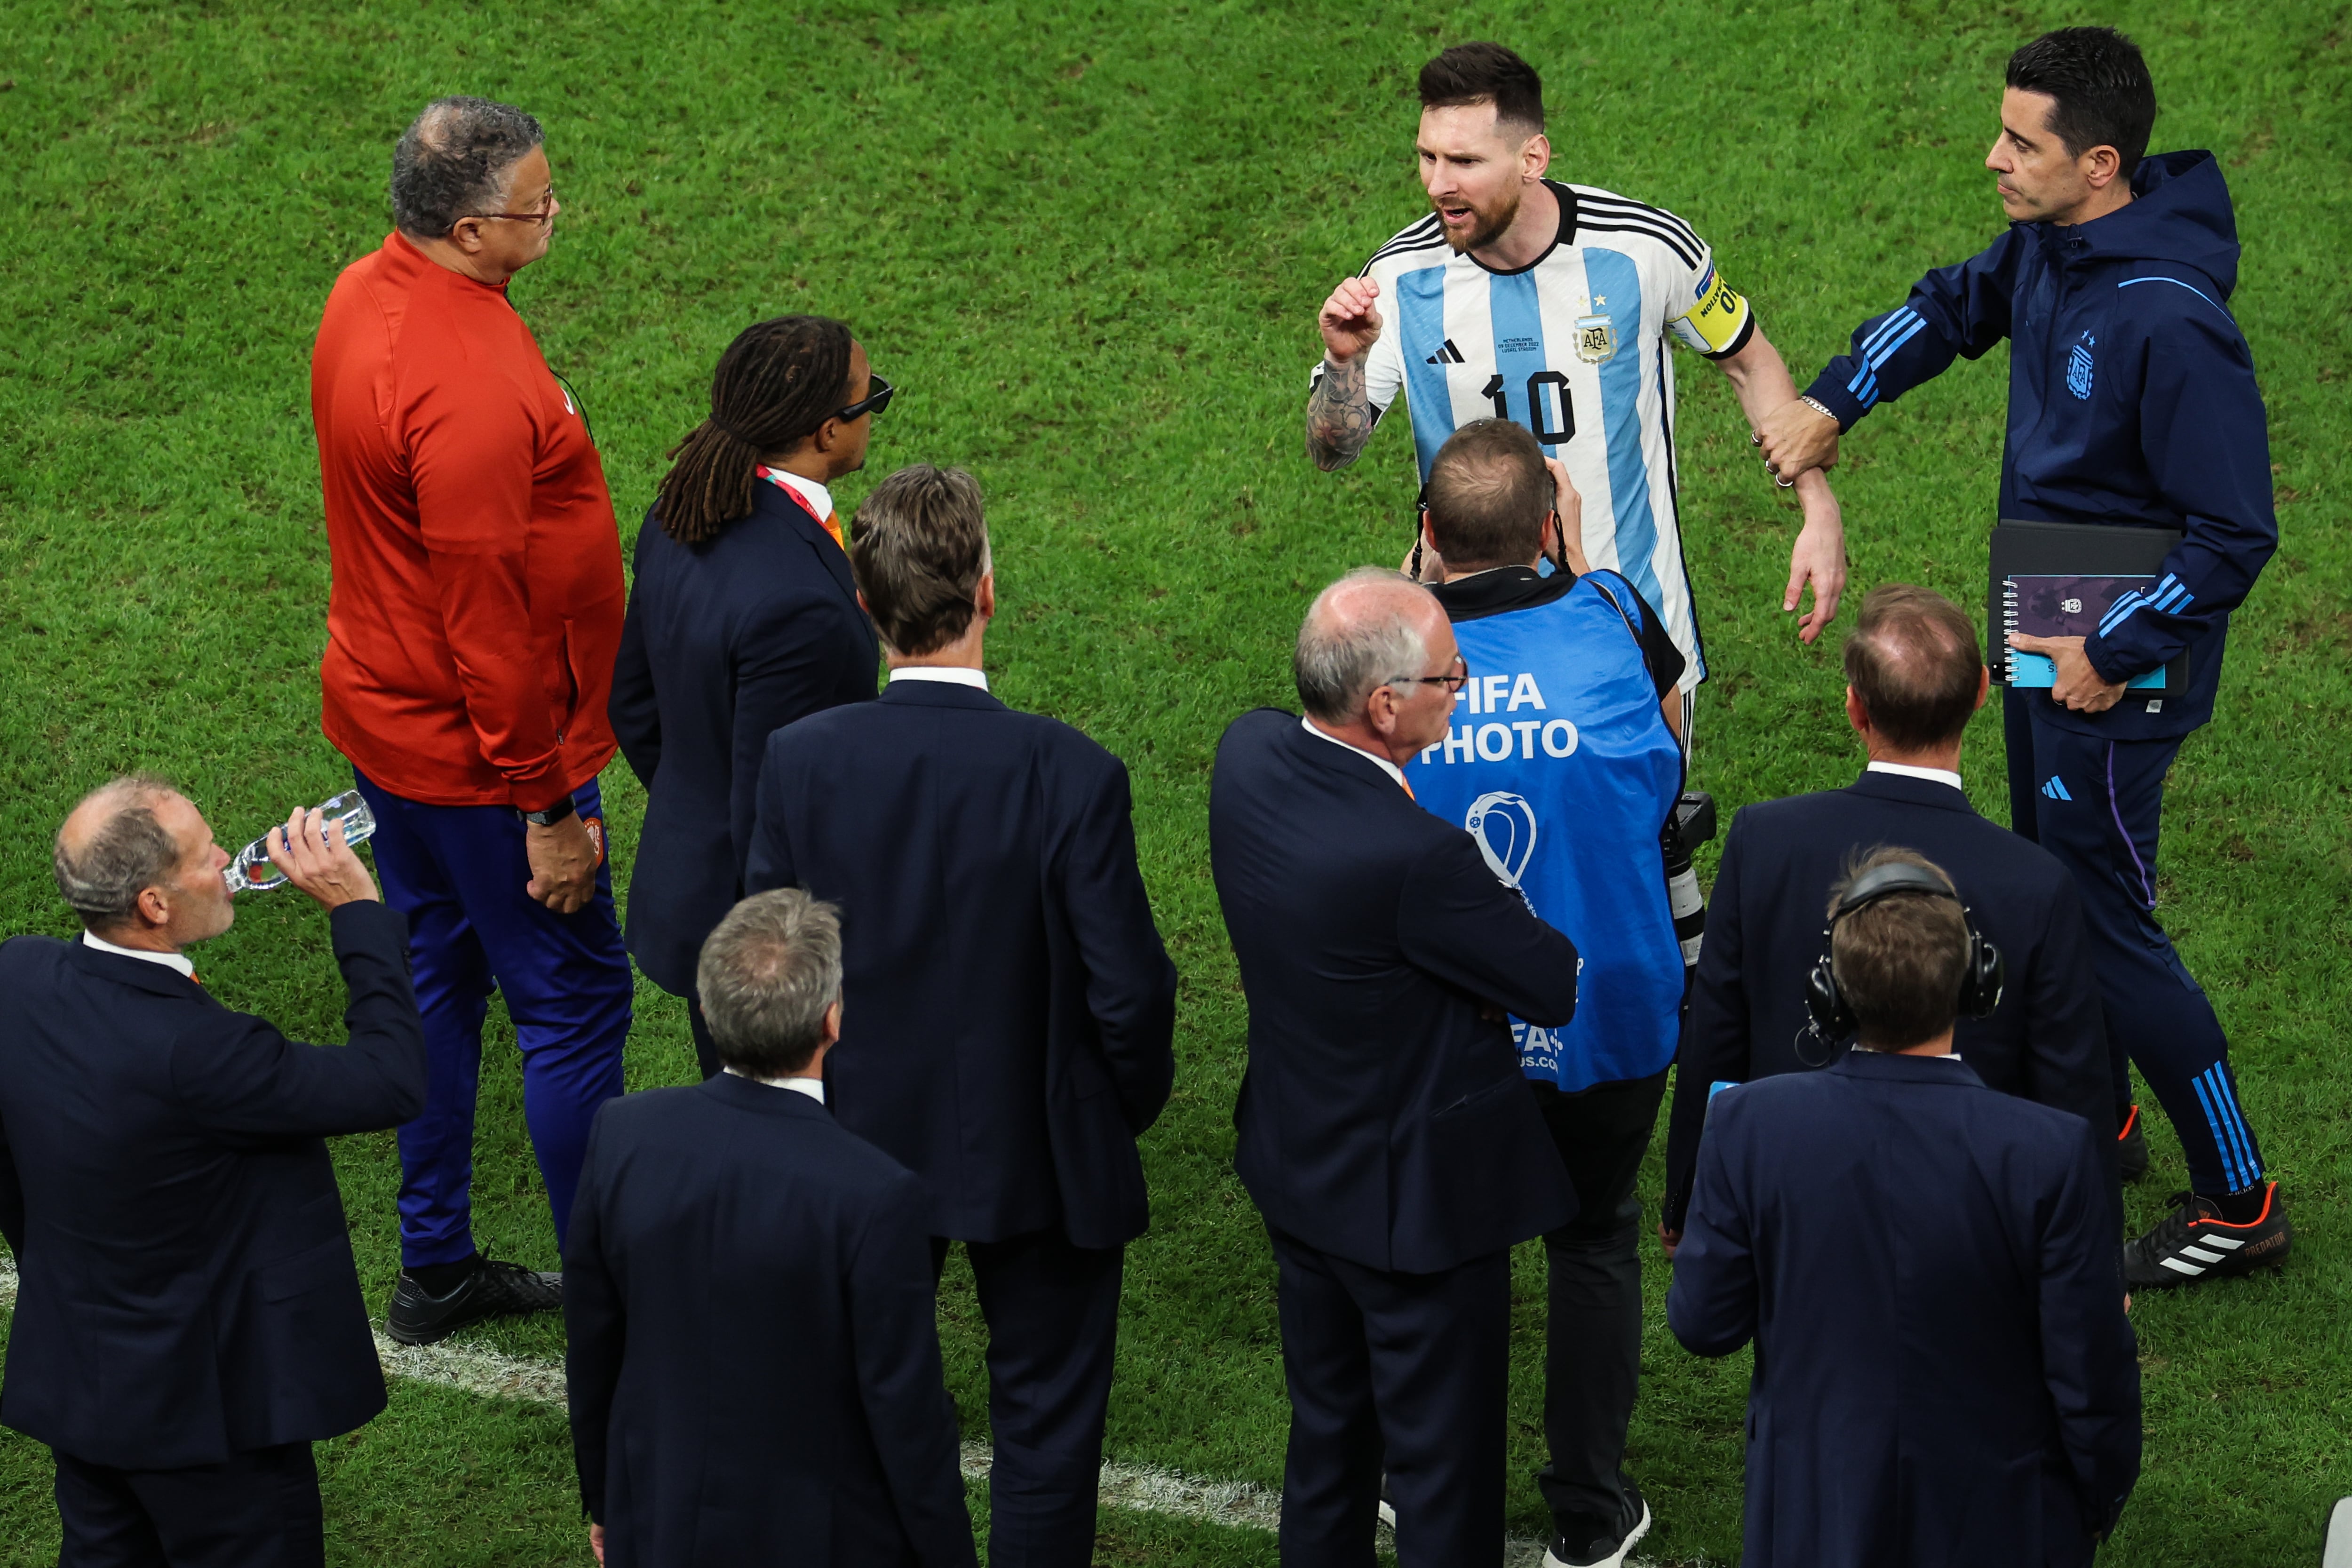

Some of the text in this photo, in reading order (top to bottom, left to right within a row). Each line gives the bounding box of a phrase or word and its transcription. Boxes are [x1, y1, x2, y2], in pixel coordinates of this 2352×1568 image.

[1583, 327, 1607, 350] AFA
[1481, 371, 1576, 446] 10
[2245, 1231, 2286, 1258] PREDATOR
